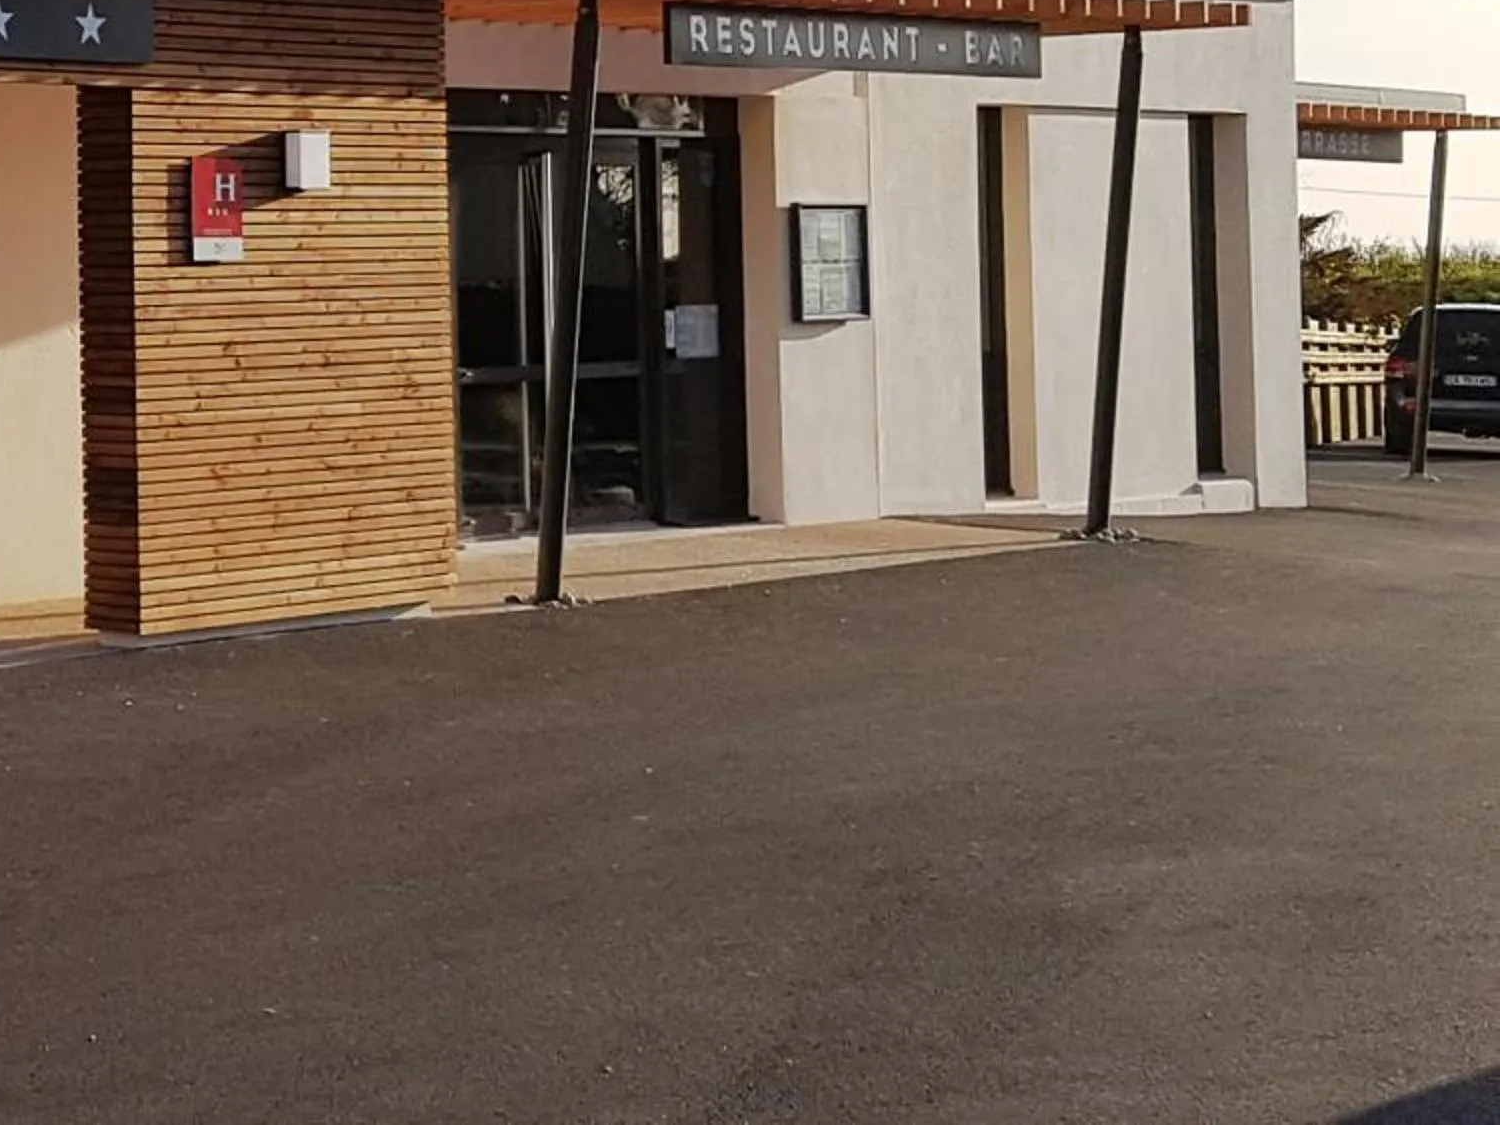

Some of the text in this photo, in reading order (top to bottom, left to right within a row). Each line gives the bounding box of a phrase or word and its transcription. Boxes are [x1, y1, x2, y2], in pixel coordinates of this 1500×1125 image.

[689, 14, 920, 63] RESTAURANT
[965, 30, 1025, 67] BAR
[215, 173, 236, 202] H
